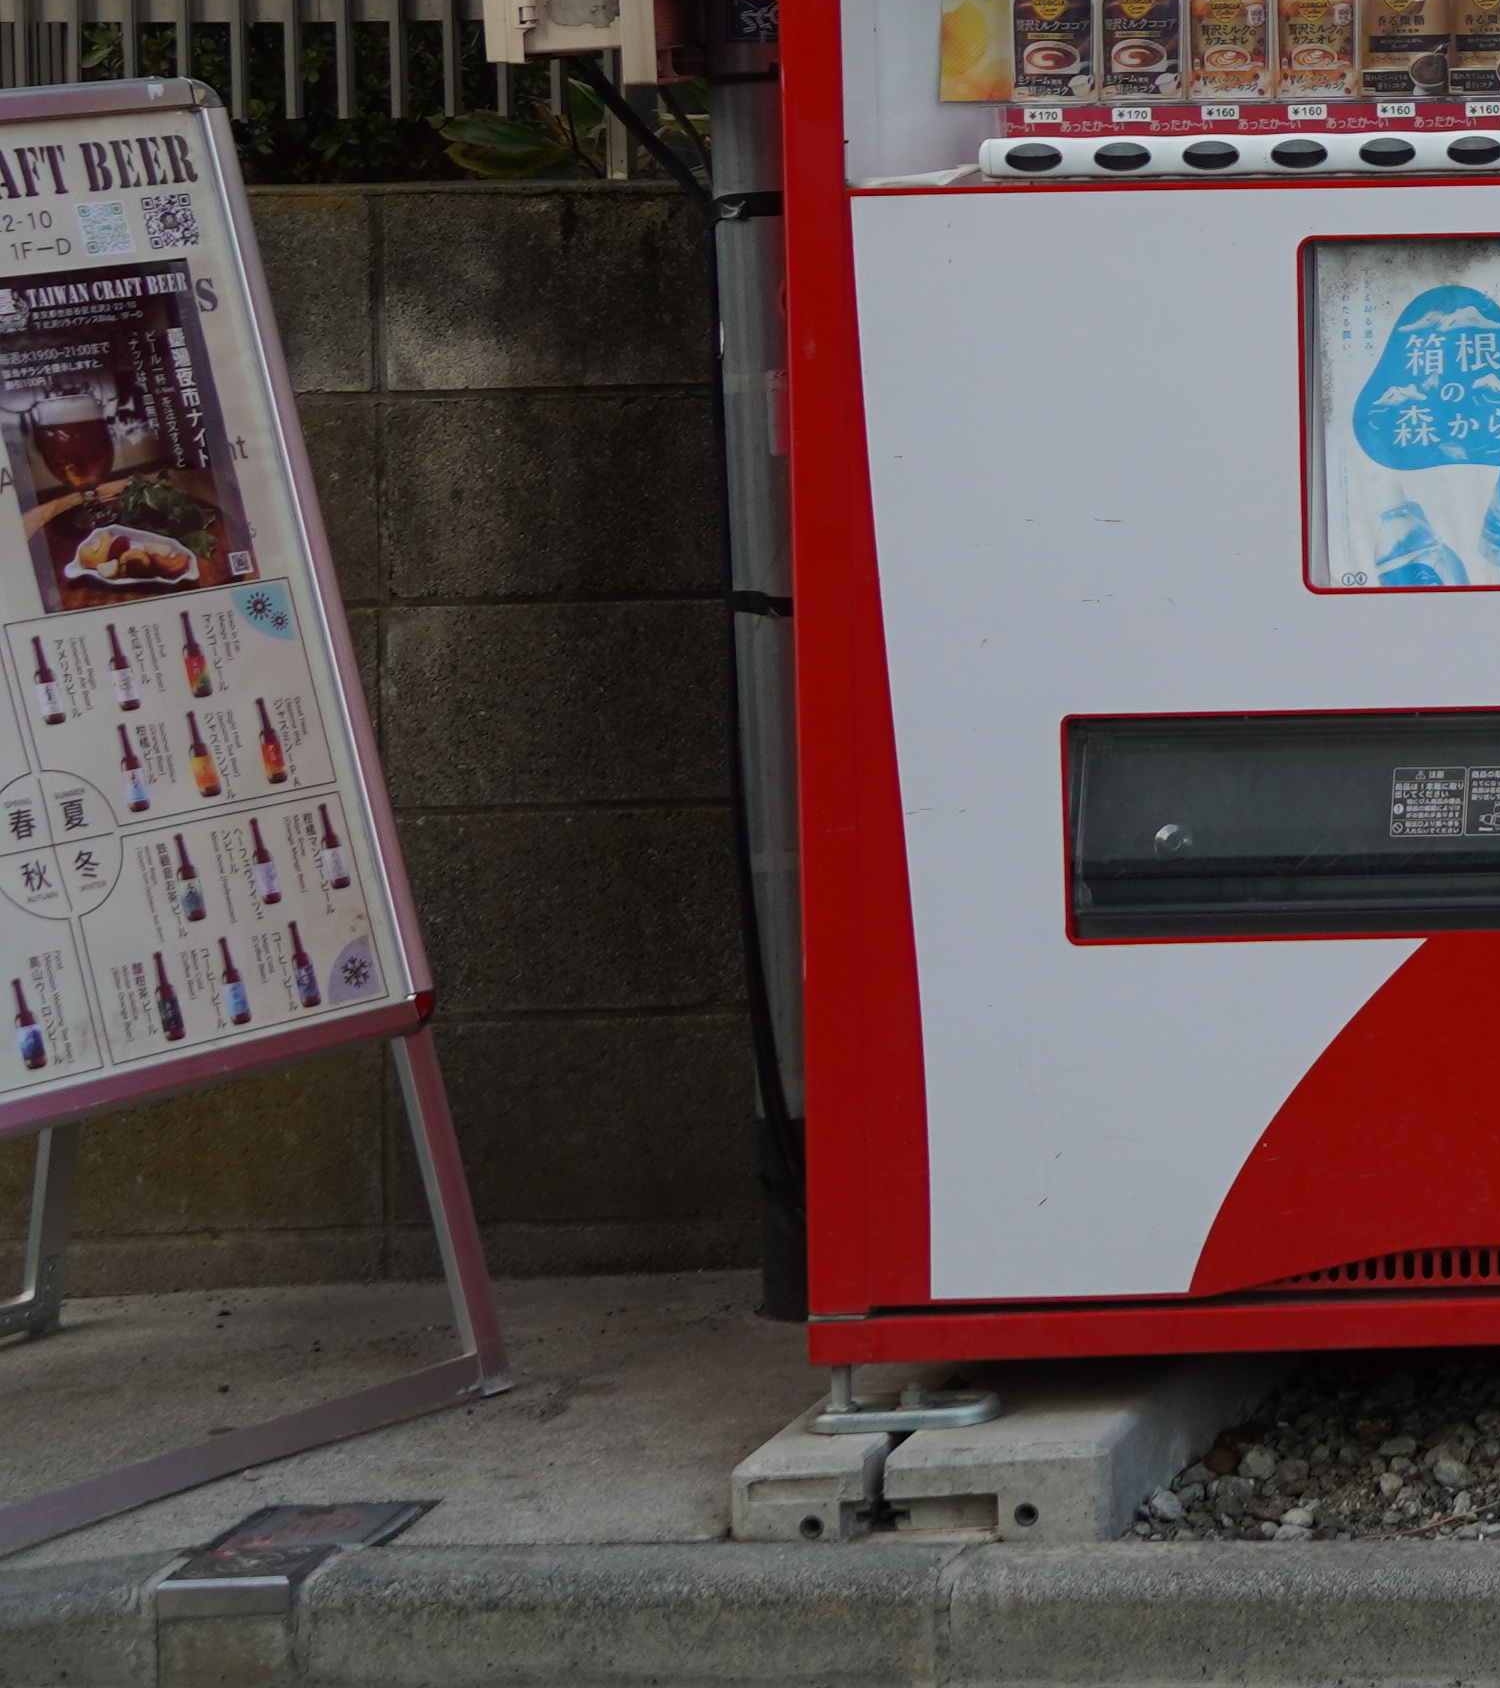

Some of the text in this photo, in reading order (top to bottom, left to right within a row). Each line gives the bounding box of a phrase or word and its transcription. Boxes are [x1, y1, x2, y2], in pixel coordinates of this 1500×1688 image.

[1202, 35, 1250, 46] カフェオレ
[79, 134, 198, 192] BEER
[26, 272, 188, 309] TAIWAN CRAFT BEER
[1440, 380, 1466, 404] の
[9, 809, 36, 841] 春
[60, 798, 89, 831] 夏
[22, 861, 51, 892] 秋
[74, 849, 99, 879] 冬
